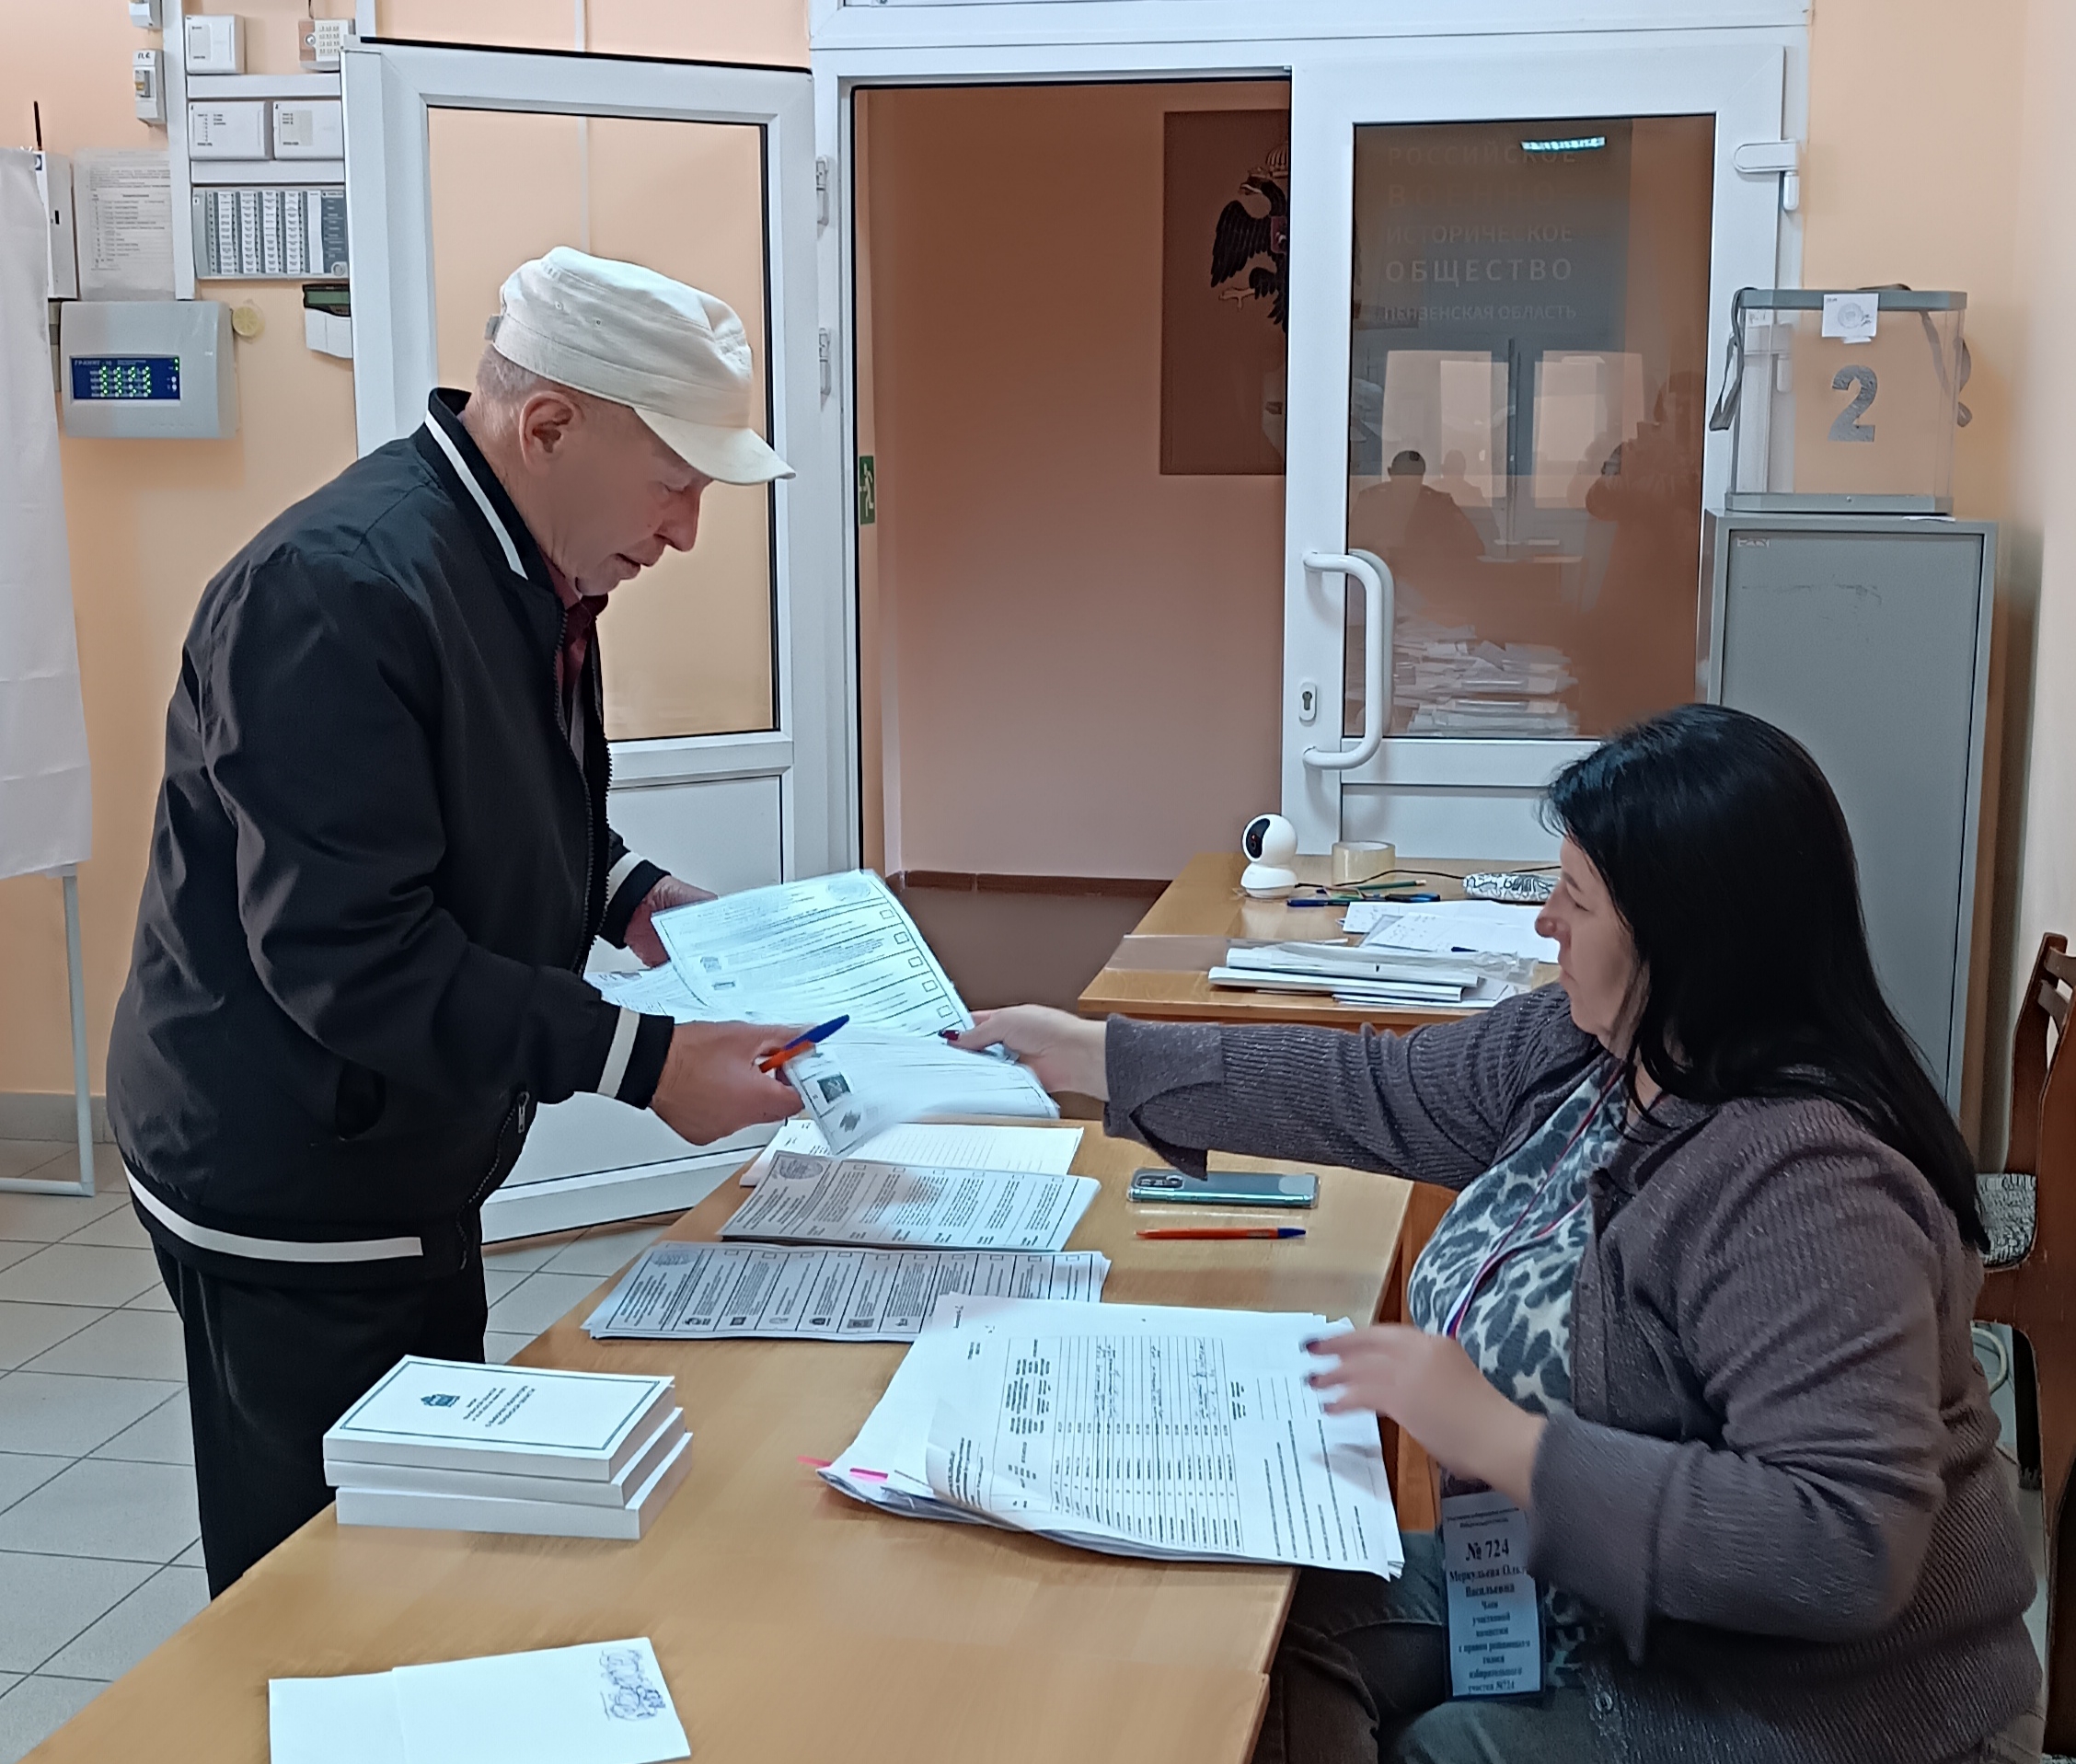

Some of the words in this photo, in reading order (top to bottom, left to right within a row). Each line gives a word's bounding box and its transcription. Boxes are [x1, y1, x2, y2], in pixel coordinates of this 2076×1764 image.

[1385, 258, 1573, 288] ОБЩЕСТВО
[1497, 304, 1577, 321] ОБЛАСТЬ
[1828, 364, 1878, 443] 2
[1484, 1538, 1510, 1560] 724
